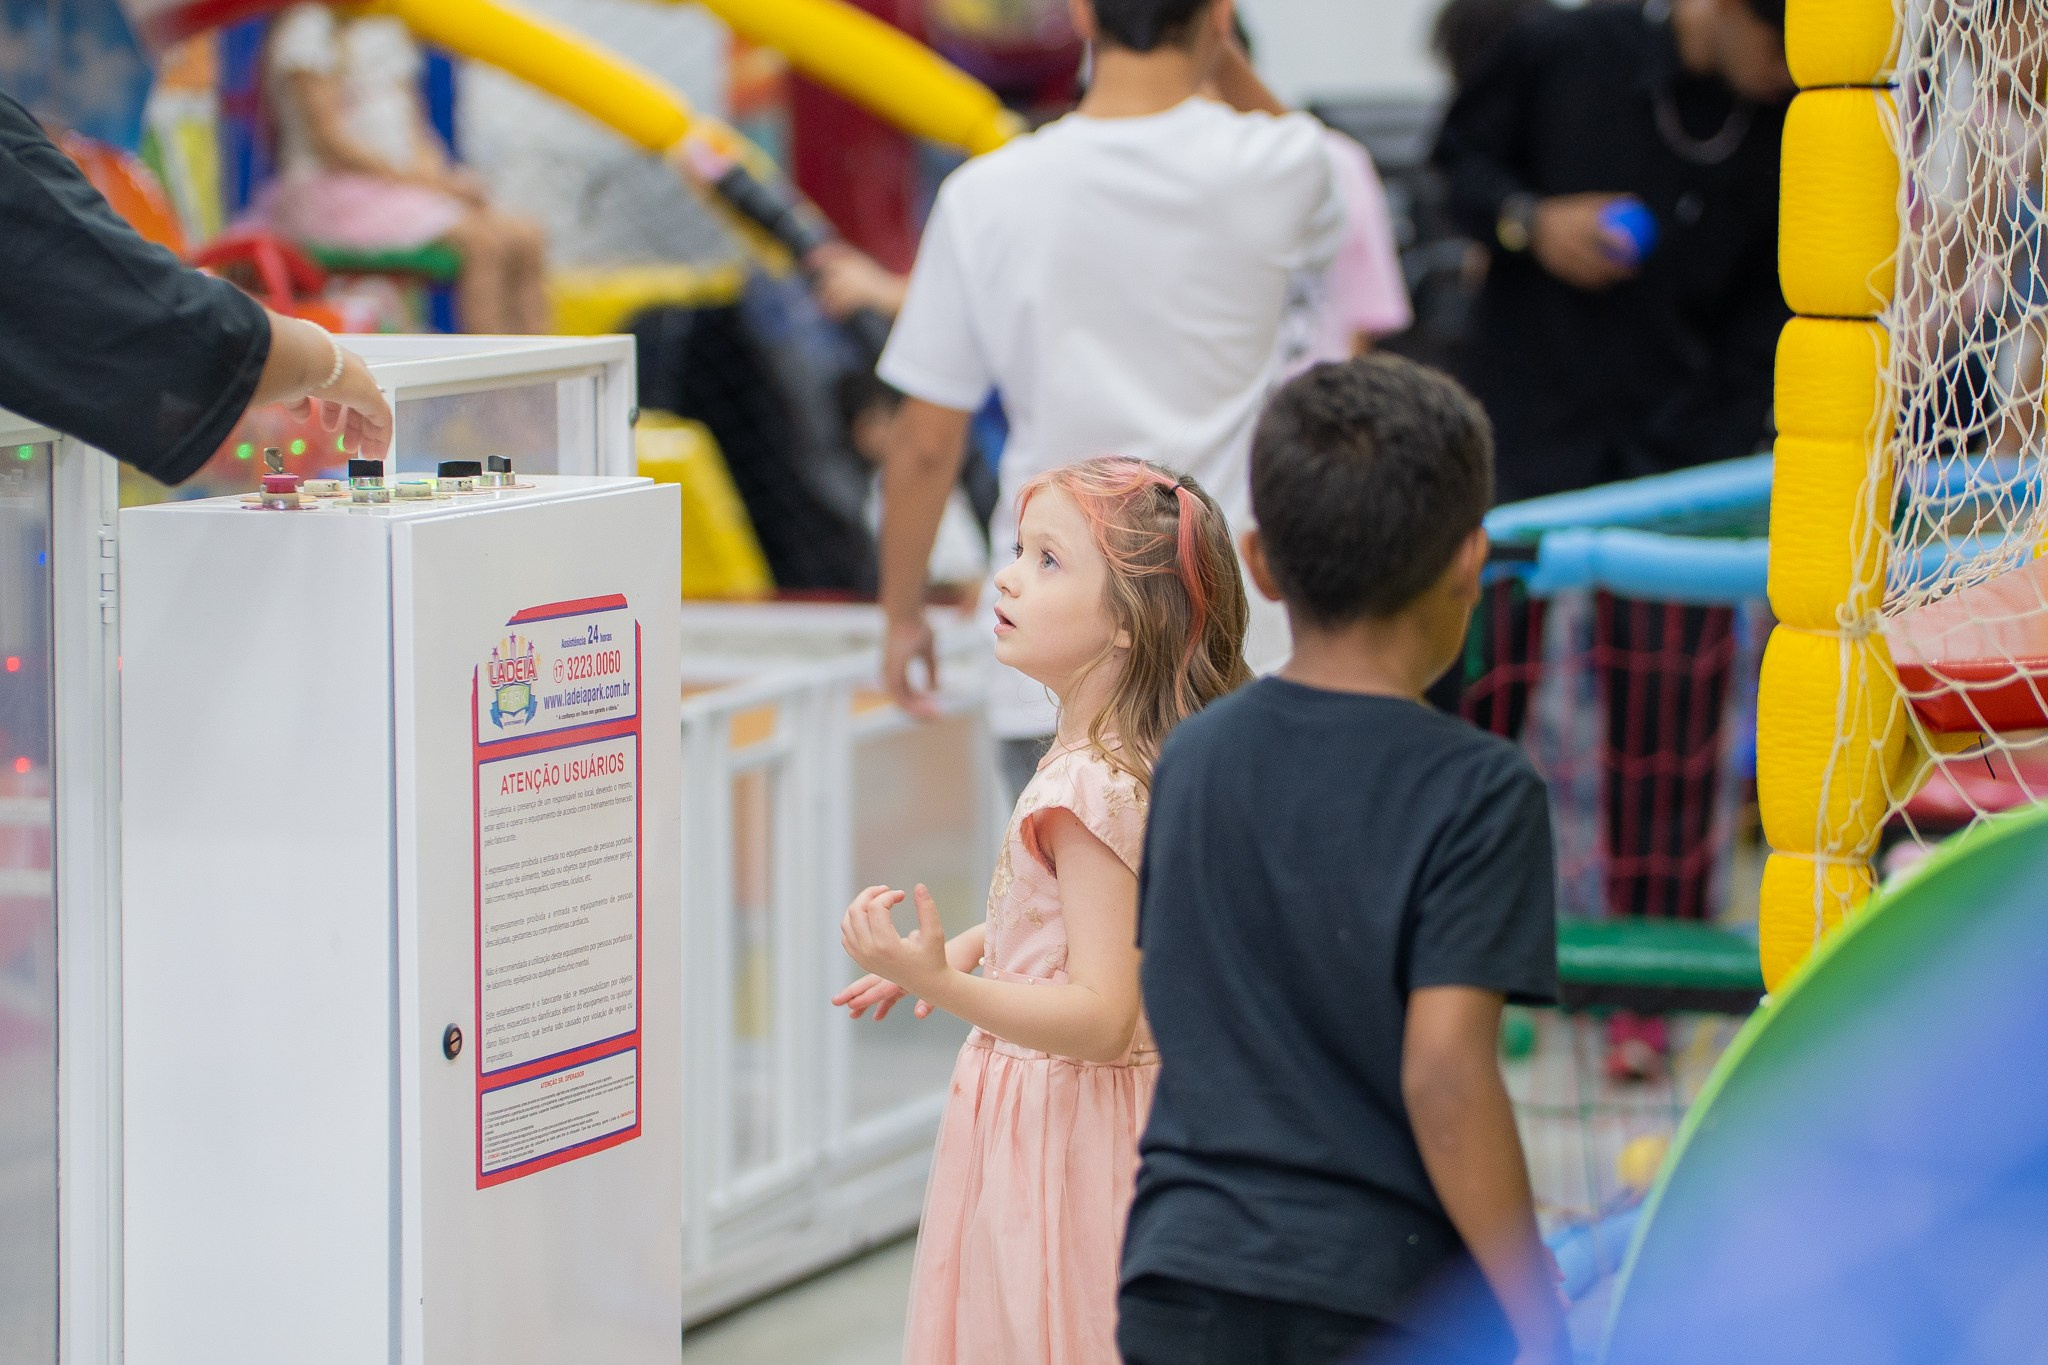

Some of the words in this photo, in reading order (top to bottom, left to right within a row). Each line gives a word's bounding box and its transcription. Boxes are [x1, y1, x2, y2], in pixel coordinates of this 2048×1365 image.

[561, 636, 586, 648] Assistência
[588, 624, 598, 644] 24
[600, 633, 612, 642] horas
[488, 656, 538, 687] LADEIA
[567, 650, 620, 680] 3223.0060
[544, 679, 630, 709] www.ladeiapark.com.br
[500, 763, 560, 796] ATENÇÃO
[564, 752, 624, 782] USUÁRIOS
